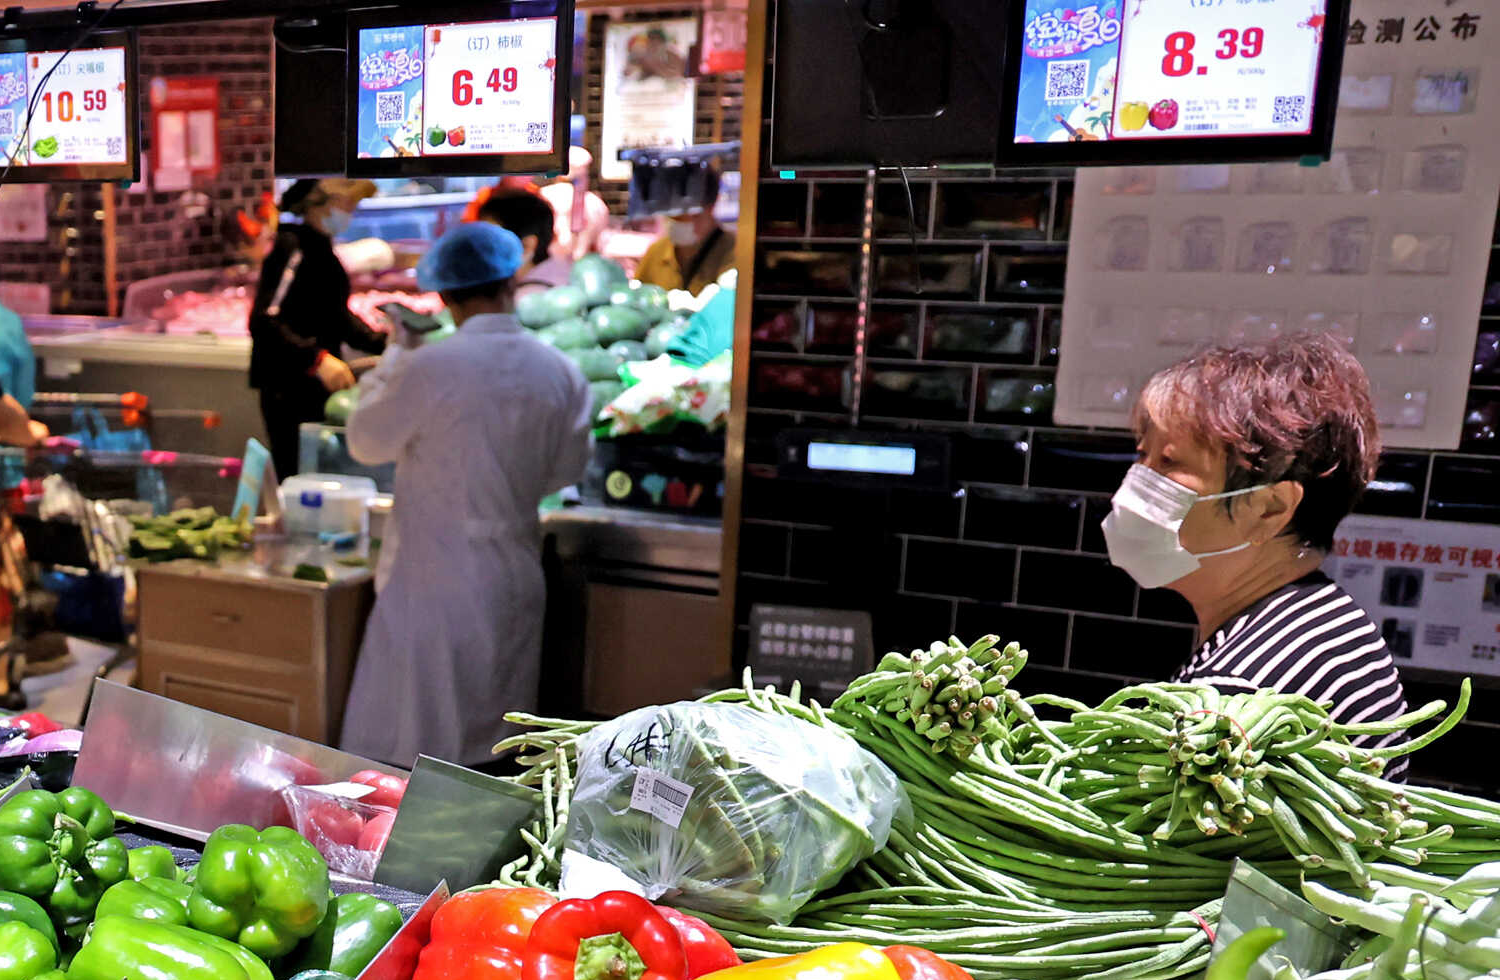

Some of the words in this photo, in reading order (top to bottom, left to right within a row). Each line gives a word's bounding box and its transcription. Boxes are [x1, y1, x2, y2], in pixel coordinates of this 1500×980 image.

[1161, 27, 1264, 77] 8.39
[42, 89, 107, 122] 10.59
[452, 67, 518, 106] 6.49
